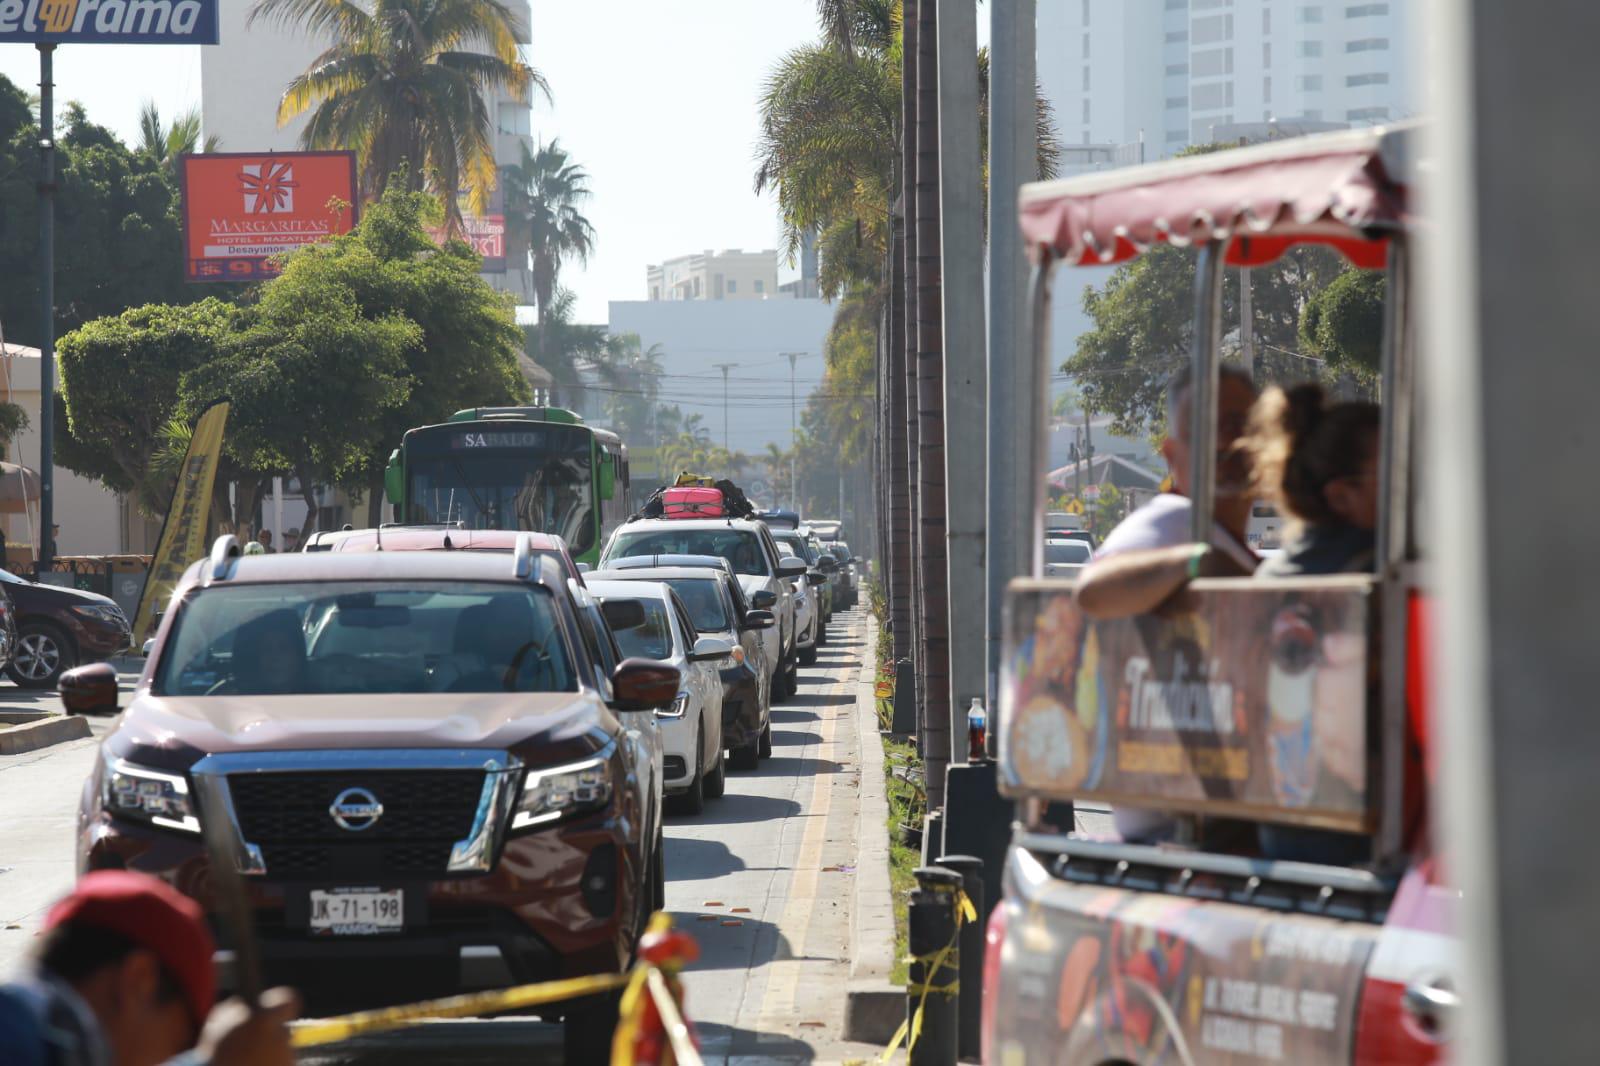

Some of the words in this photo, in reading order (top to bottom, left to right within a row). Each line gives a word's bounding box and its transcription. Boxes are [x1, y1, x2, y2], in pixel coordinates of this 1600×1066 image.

[216, 236, 252, 244] HOTEL
[228, 245, 284, 255] Desayunos
[464, 432, 535, 447] SABALO
